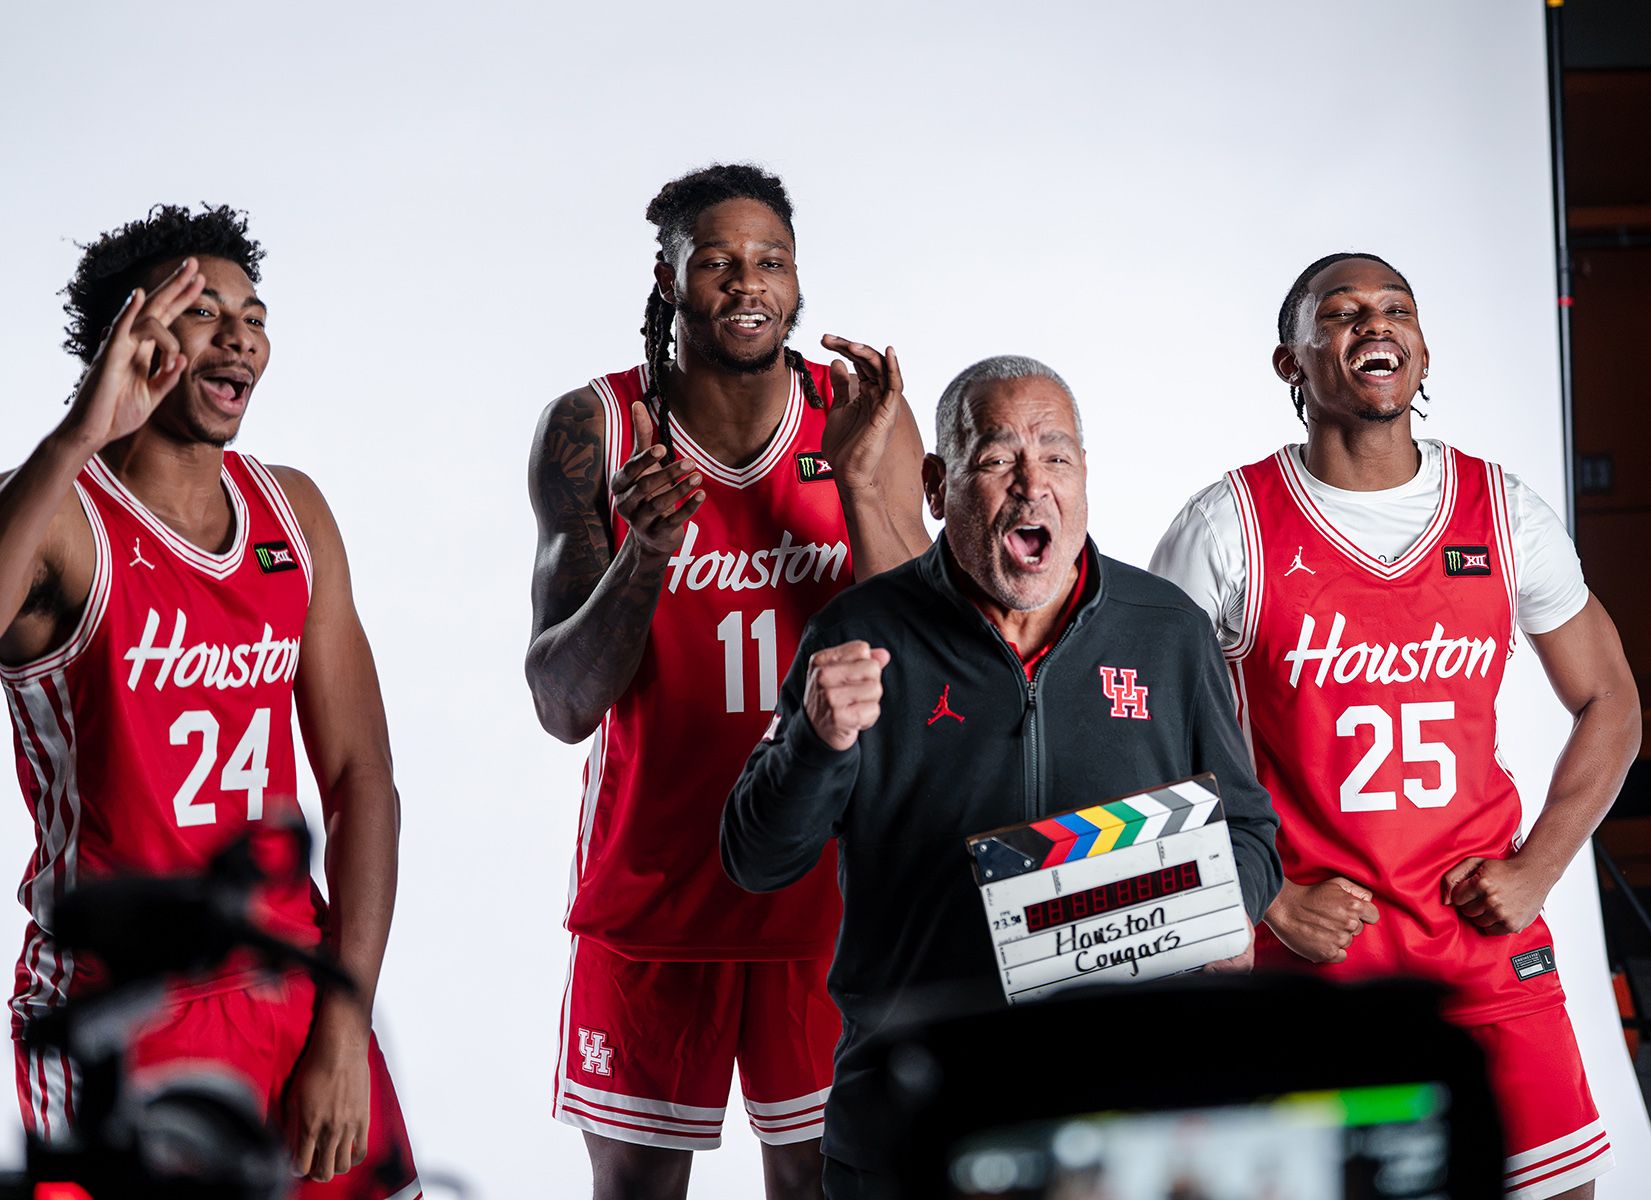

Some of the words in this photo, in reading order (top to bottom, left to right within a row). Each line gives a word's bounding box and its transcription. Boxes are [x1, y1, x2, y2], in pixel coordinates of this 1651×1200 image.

[123, 606, 301, 692] Houston
[717, 608, 778, 713] 11
[1284, 611, 1497, 689] Houston
[168, 707, 271, 828] 24
[1335, 700, 1457, 813] 25
[1075, 929, 1181, 977] Cougars
[1544, 954, 1552, 965] L
